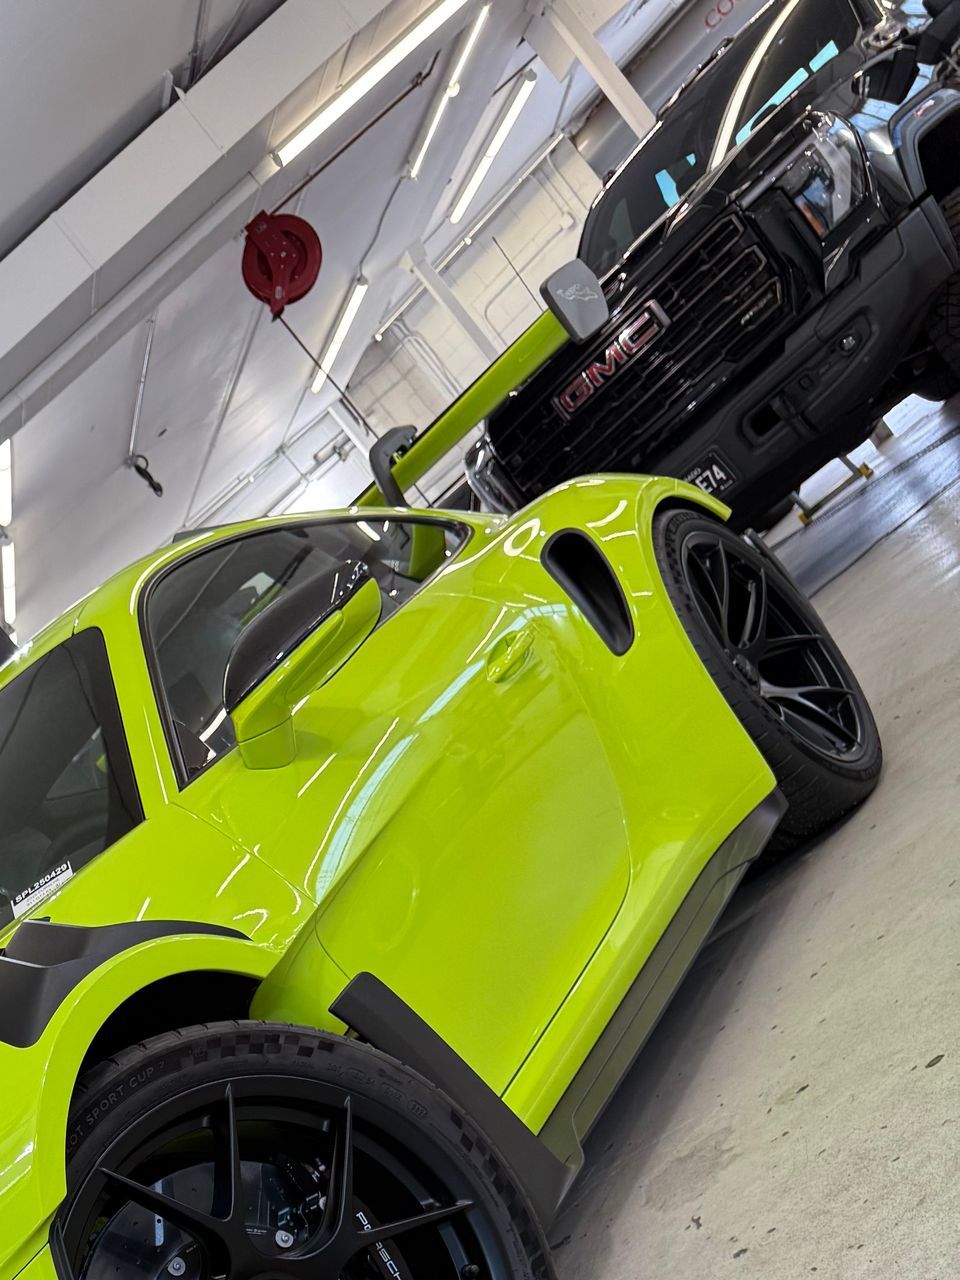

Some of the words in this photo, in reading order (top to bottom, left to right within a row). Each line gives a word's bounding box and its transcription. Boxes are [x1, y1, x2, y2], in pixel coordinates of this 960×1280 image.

[559, 311, 659, 413] GMC
[85, 1085, 127, 1126] SPORT
[128, 1066, 155, 1089] CUP
